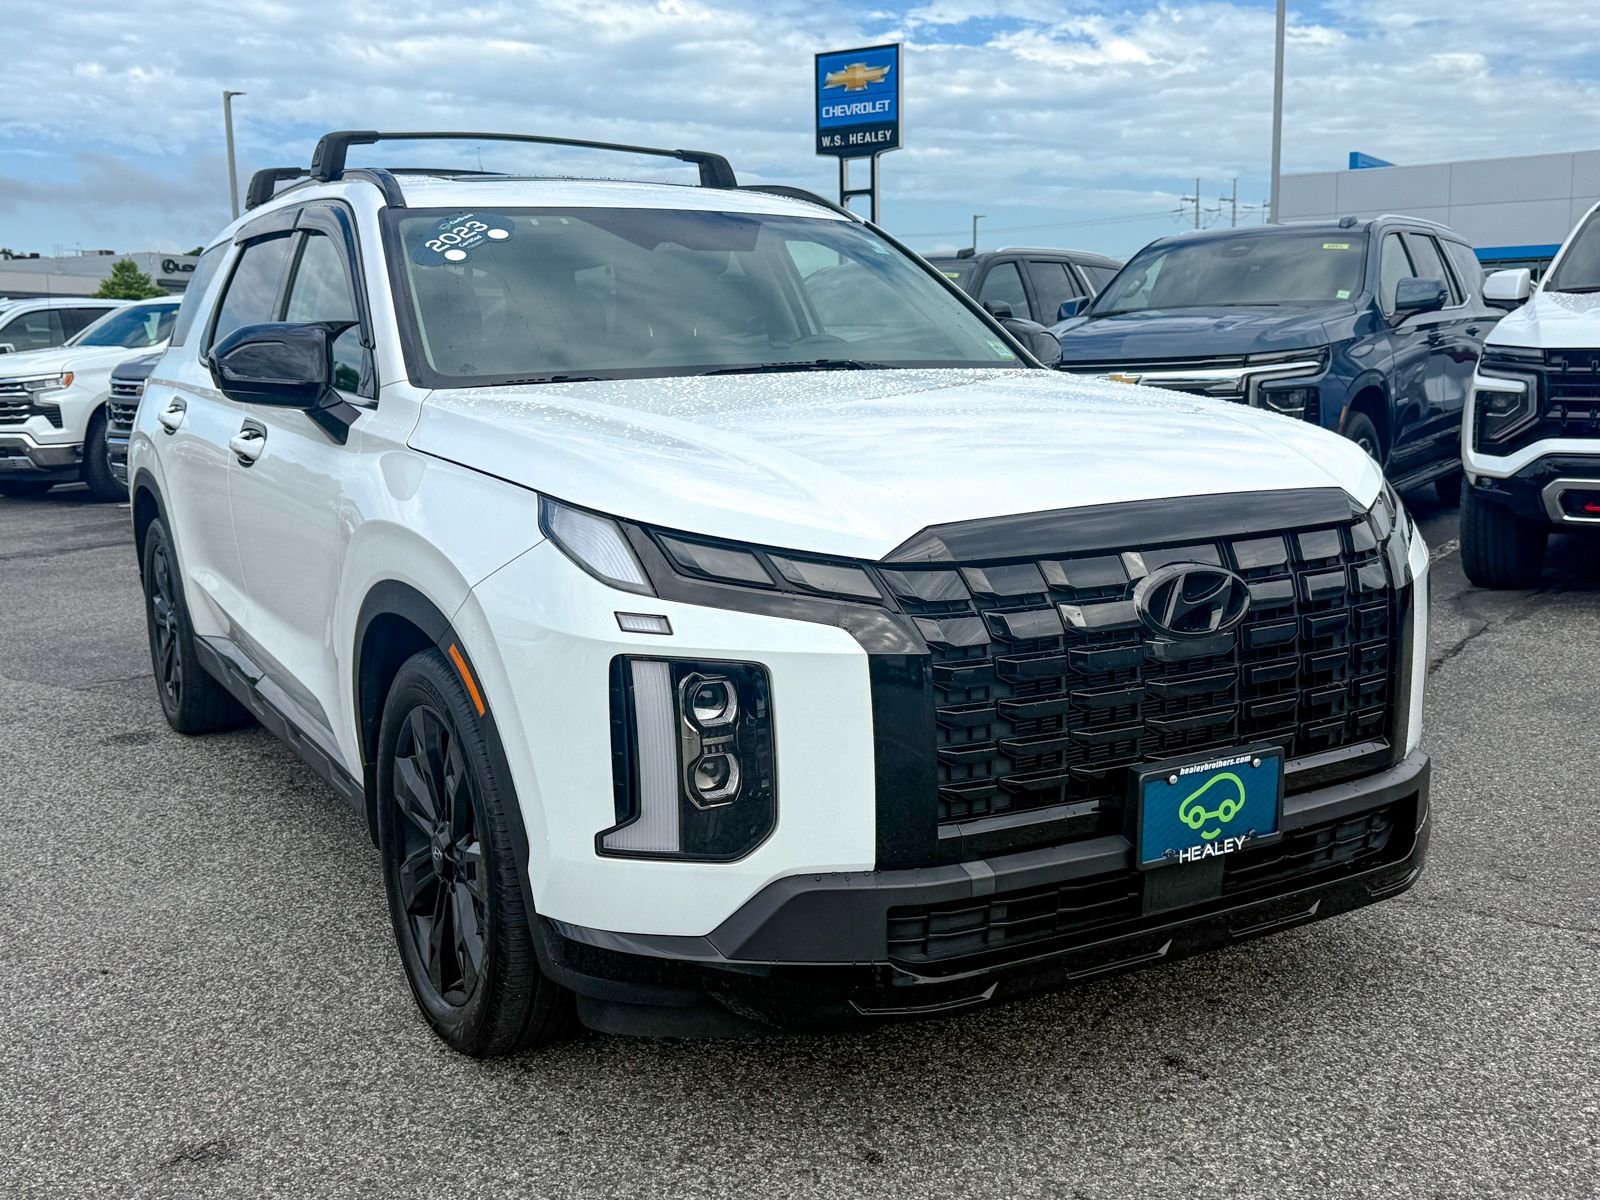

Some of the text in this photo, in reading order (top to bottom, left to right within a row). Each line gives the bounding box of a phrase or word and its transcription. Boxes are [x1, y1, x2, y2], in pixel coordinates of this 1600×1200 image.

[822, 100, 891, 118] CHEVROLET
[821, 130, 892, 147] W.S. HEALEY
[425, 221, 488, 252] 2023
[1179, 755, 1251, 776] healeybrothers.com
[1179, 836, 1246, 864] HEALEY
